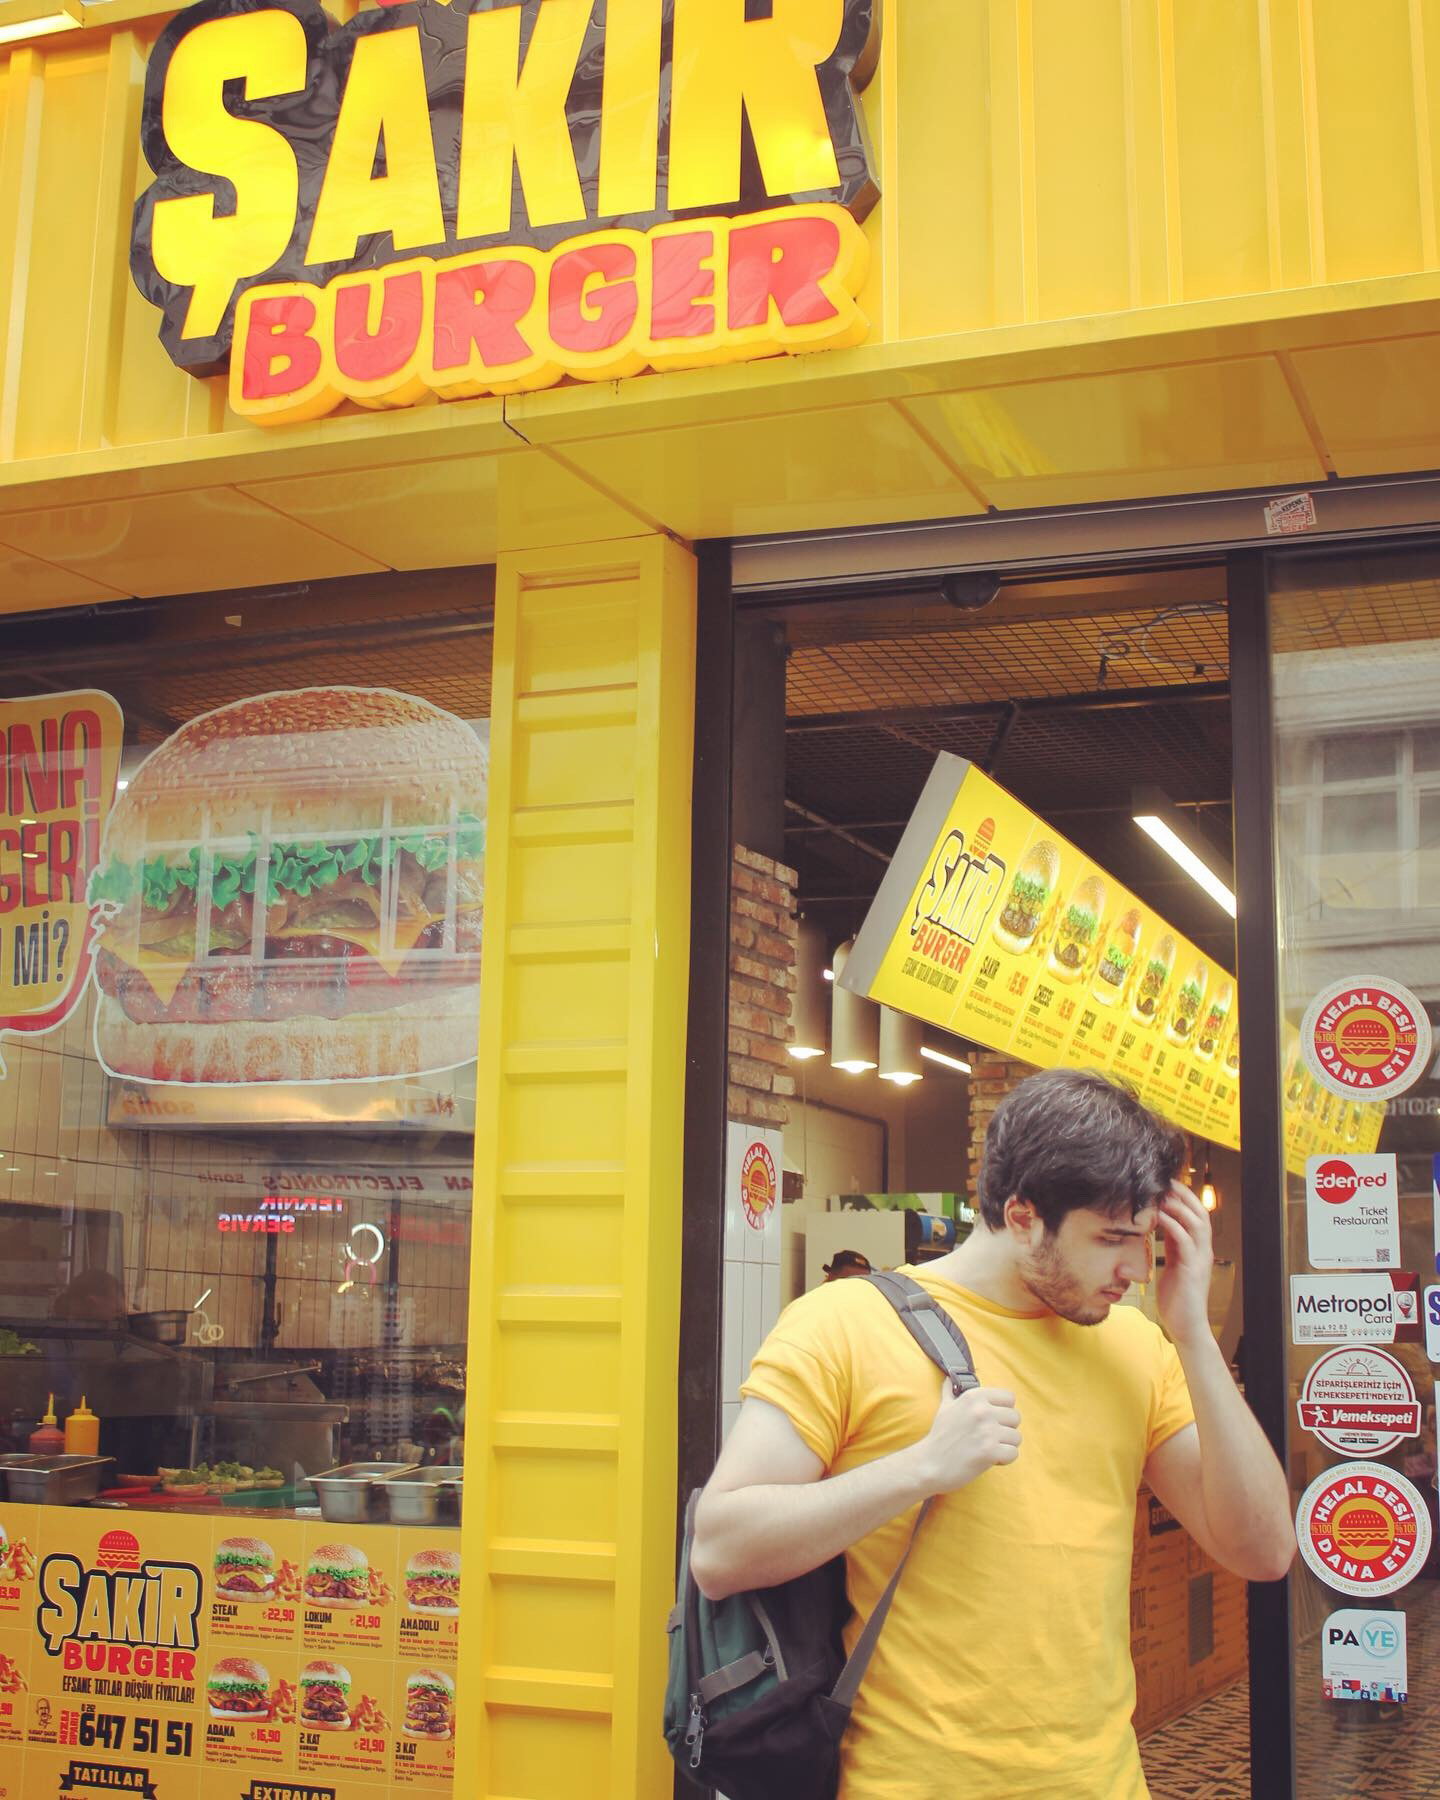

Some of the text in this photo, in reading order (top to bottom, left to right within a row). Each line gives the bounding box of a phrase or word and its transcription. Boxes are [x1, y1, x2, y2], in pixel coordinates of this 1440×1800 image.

[241, 216, 841, 399] BURGER
[0, 710, 101, 816] NA
[912, 923, 971, 974] BURGER
[1320, 993, 1416, 1033] HELAL BESİ
[1320, 1046, 1411, 1086] DANA ETİ
[1315, 1172, 1387, 1189] Edenred
[1333, 1216, 1388, 1226] Restaurant
[1360, 1206, 1388, 1216] Ticket
[1297, 1294, 1392, 1317] Metropol
[1364, 1313, 1393, 1324] Card
[1315, 1480, 1415, 1522] HELAL BESİ
[1317, 1537, 1412, 1579] DANA ETİ
[213, 1604, 238, 1616] STEAK
[305, 1611, 332, 1623] LOKUM
[400, 1618, 439, 1631] ANADOLU
[63, 1641, 196, 1681] BURGER
[62, 1675, 195, 1704] EFSANE TATLAR DÜŞÜK FİYATLAR!
[79, 1711, 126, 1750] 647
[133, 1717, 159, 1754] 51
[165, 1721, 193, 1757] 51
[207, 1724, 235, 1737] ADANA
[307, 1734, 320, 1745] KAT
[73, 1767, 144, 1787] TATLILAR
